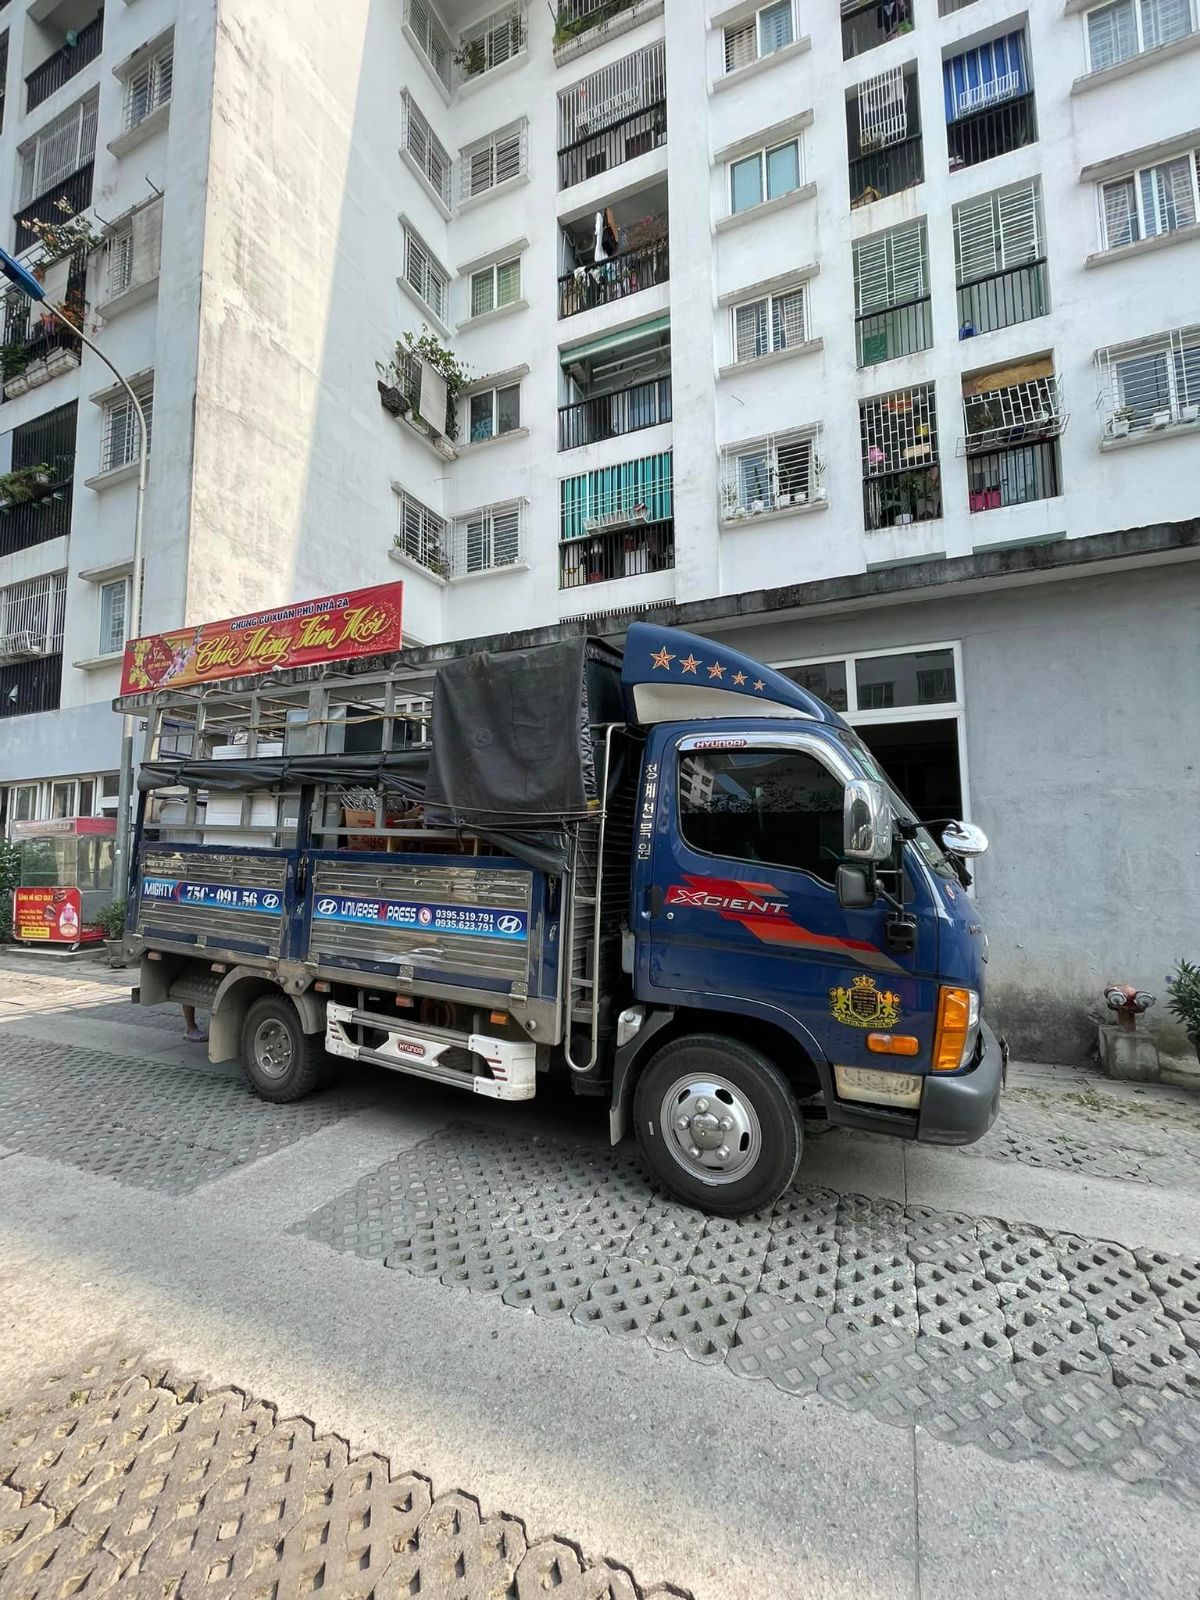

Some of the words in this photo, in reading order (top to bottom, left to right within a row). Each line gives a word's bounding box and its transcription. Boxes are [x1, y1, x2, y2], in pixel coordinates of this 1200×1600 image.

[230, 617, 257, 631] CHUNG
[316, 599, 335, 613] NHÀ
[336, 597, 349, 609] 2A
[195, 635, 240, 672] Chúc
[697, 740, 744, 748] HYUNDAI
[144, 882, 173, 898] MIGHTY
[671, 889, 789, 913] XCIENT
[435, 909, 494, 923] 0395.519.791
[435, 918, 494, 932] 0935.623.791
[399, 1043, 424, 1055] HYUNDAI
